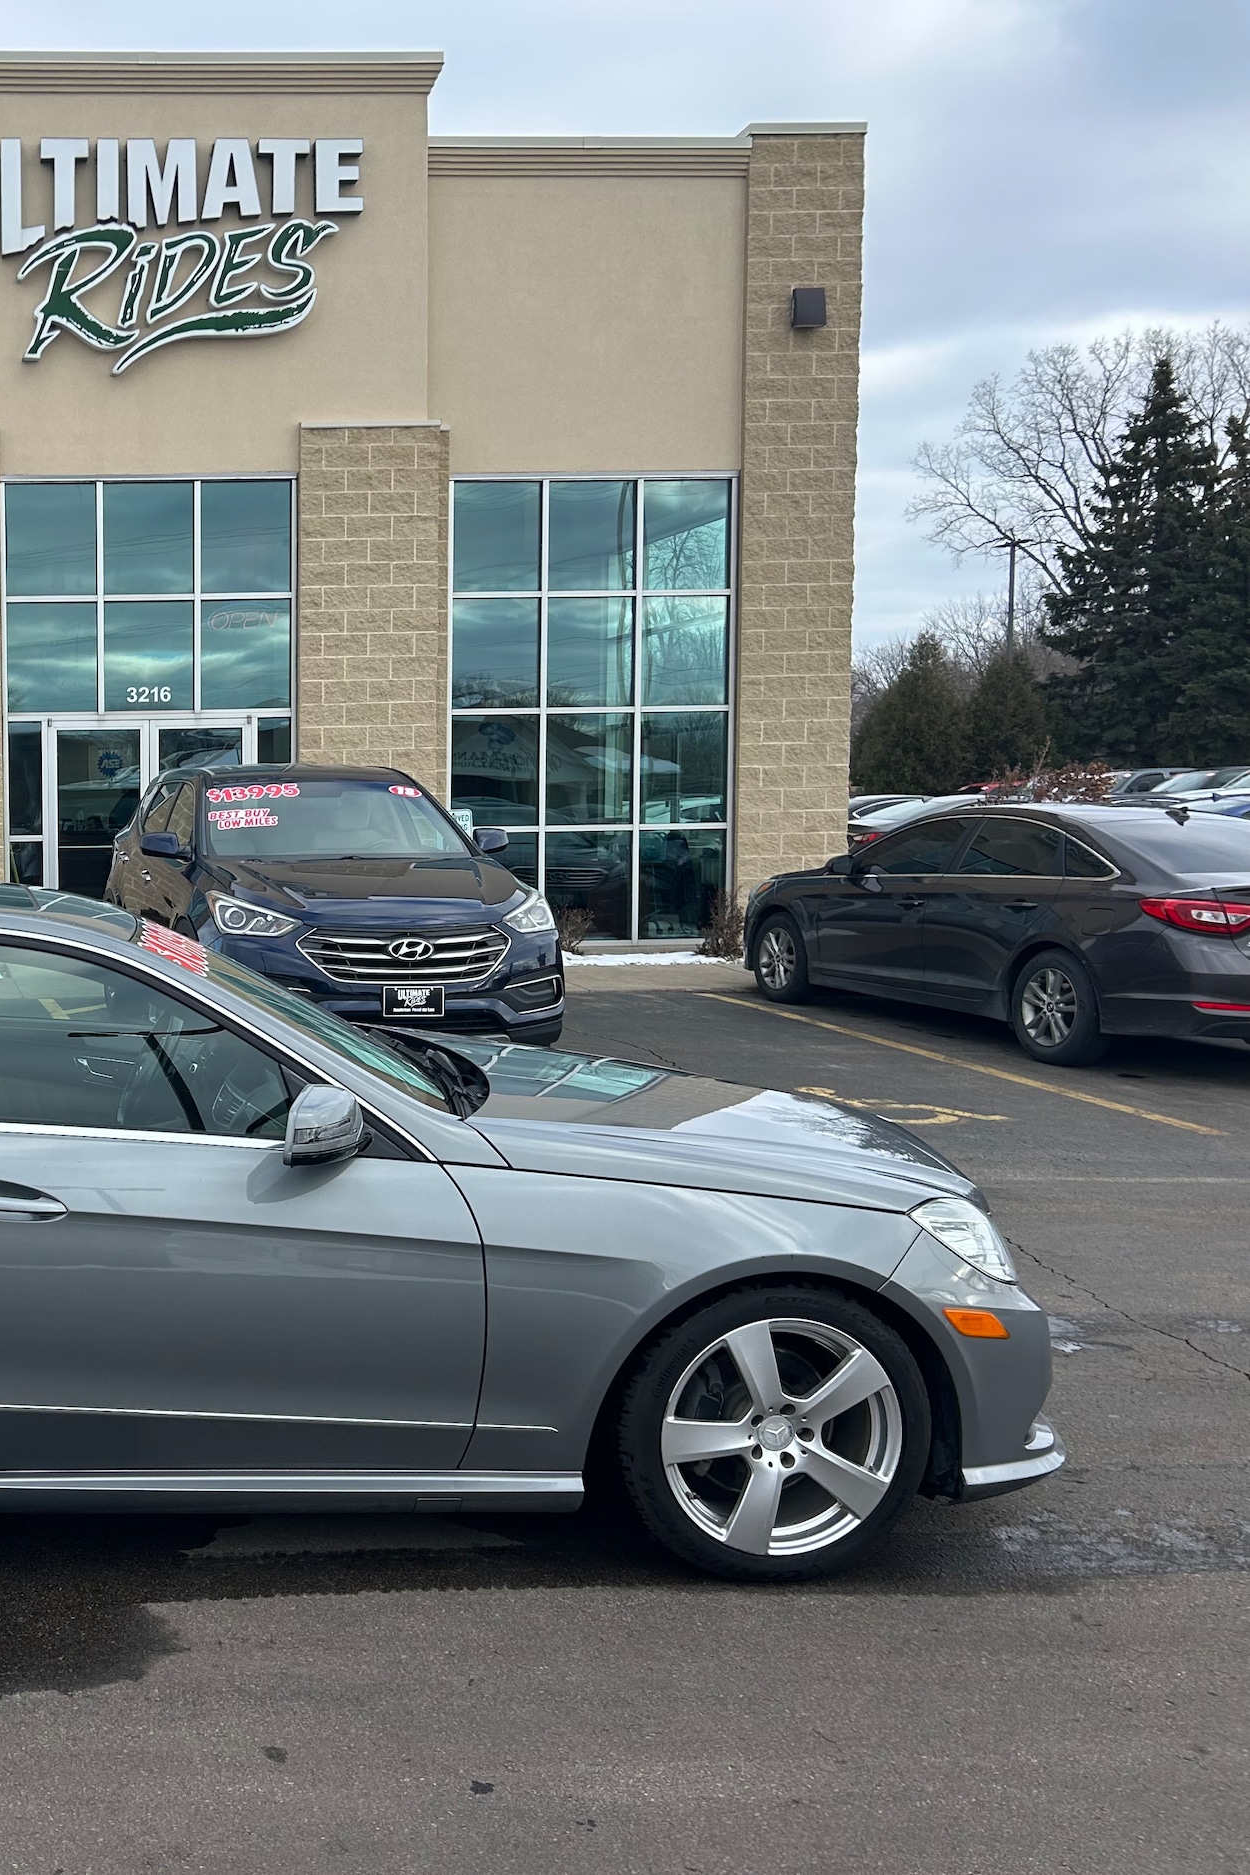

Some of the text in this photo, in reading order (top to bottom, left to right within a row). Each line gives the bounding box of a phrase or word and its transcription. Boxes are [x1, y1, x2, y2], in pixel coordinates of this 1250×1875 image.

[210, 611, 279, 631] OPEN
[126, 686, 171, 703] 3216
[100, 759, 120, 768] ASE
[206, 783, 300, 802] $13995
[208, 808, 270, 821] BEST BUY
[219, 816, 278, 830] LOW MILES
[397, 989, 431, 1000] ULTIMATE
